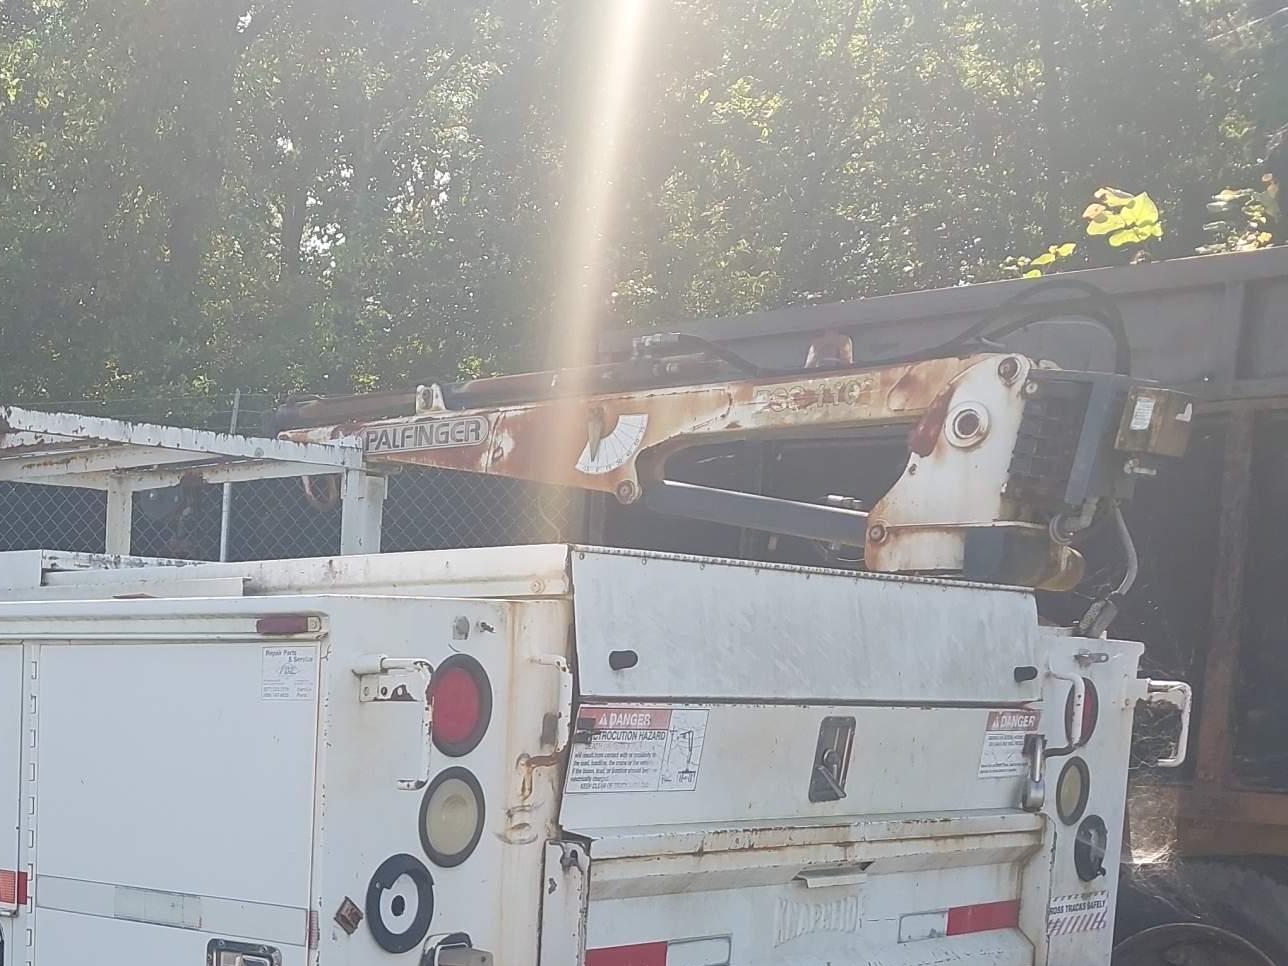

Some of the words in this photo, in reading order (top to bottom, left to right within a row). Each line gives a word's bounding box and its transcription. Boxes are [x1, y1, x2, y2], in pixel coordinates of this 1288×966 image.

[366, 420, 481, 452] PALFINGER
[610, 712, 652, 727] DANGER
[1000, 715, 1036, 728] DANGER
[638, 730, 666, 741] HAZARD
[1065, 902, 1086, 912] TRACKS
[1087, 900, 1106, 911] SAFELY
